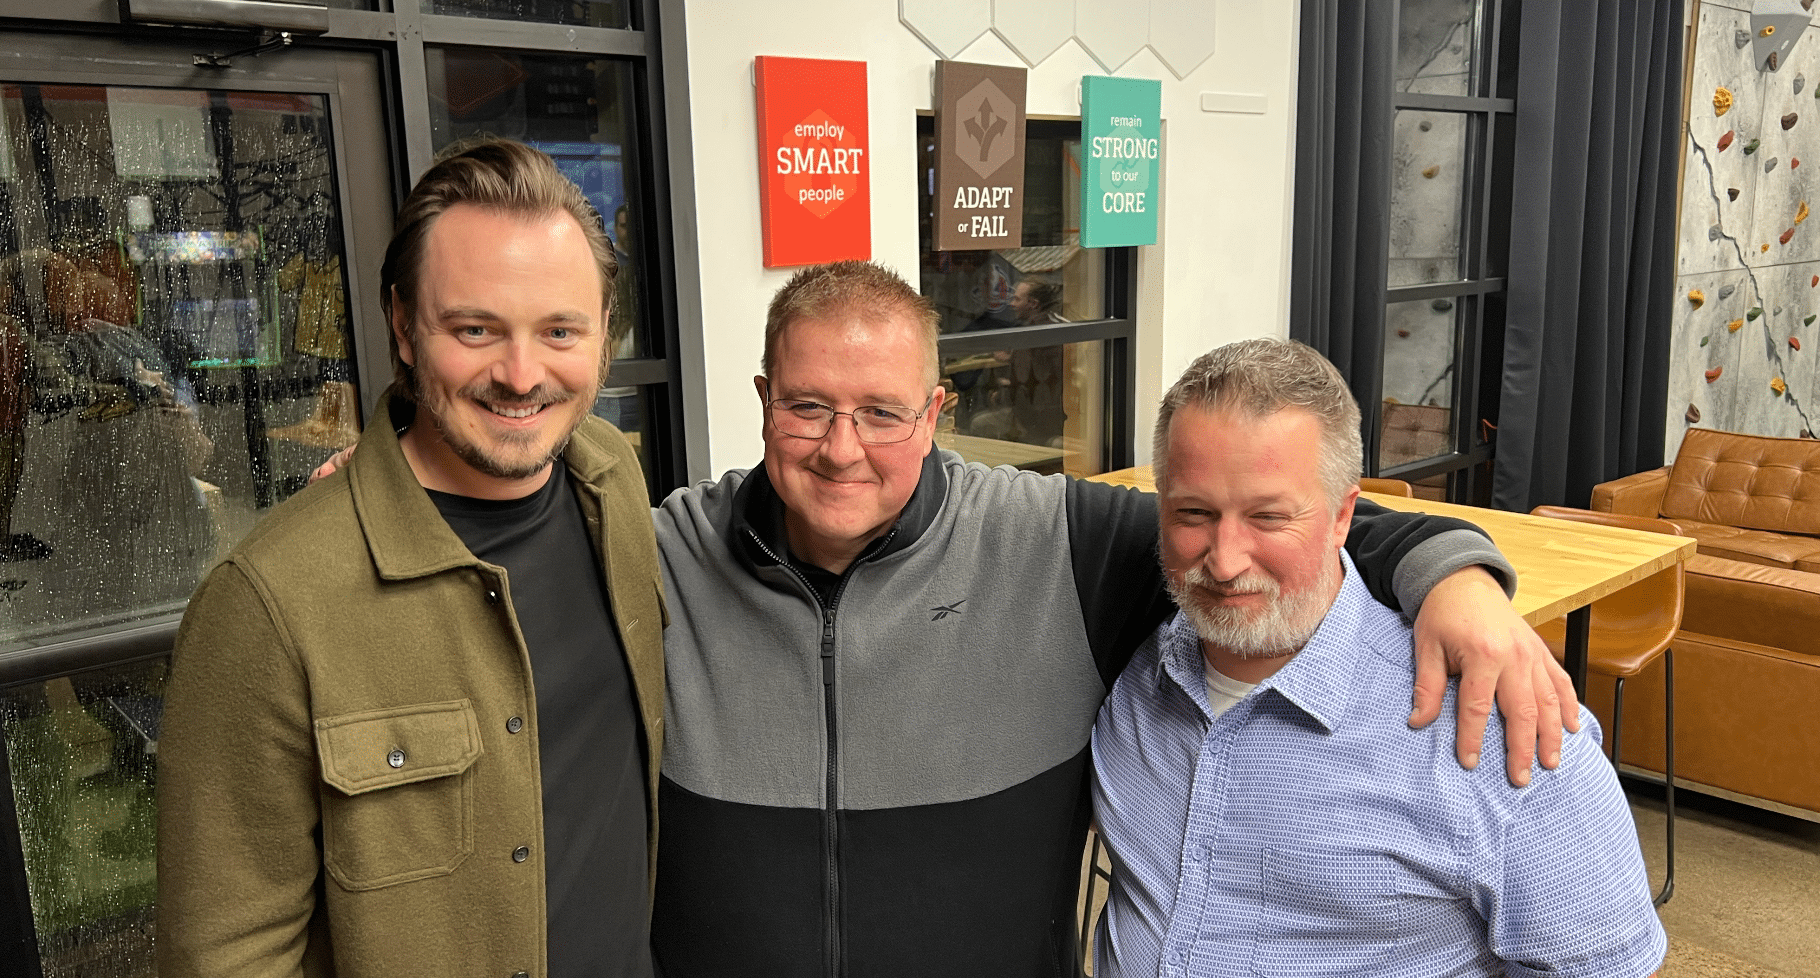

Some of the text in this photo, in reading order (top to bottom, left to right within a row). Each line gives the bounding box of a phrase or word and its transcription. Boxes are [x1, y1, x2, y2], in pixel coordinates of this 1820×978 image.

[794, 120, 845, 141] employ
[1110, 114, 1142, 128] remain
[1092, 136, 1158, 160] STRONG
[776, 147, 863, 175] SMART
[1111, 170, 1138, 182] to our
[799, 184, 845, 204] people
[953, 186, 1014, 209] ADAPT
[1102, 192, 1146, 214] CORE
[957, 215, 1008, 238] or FAIL
